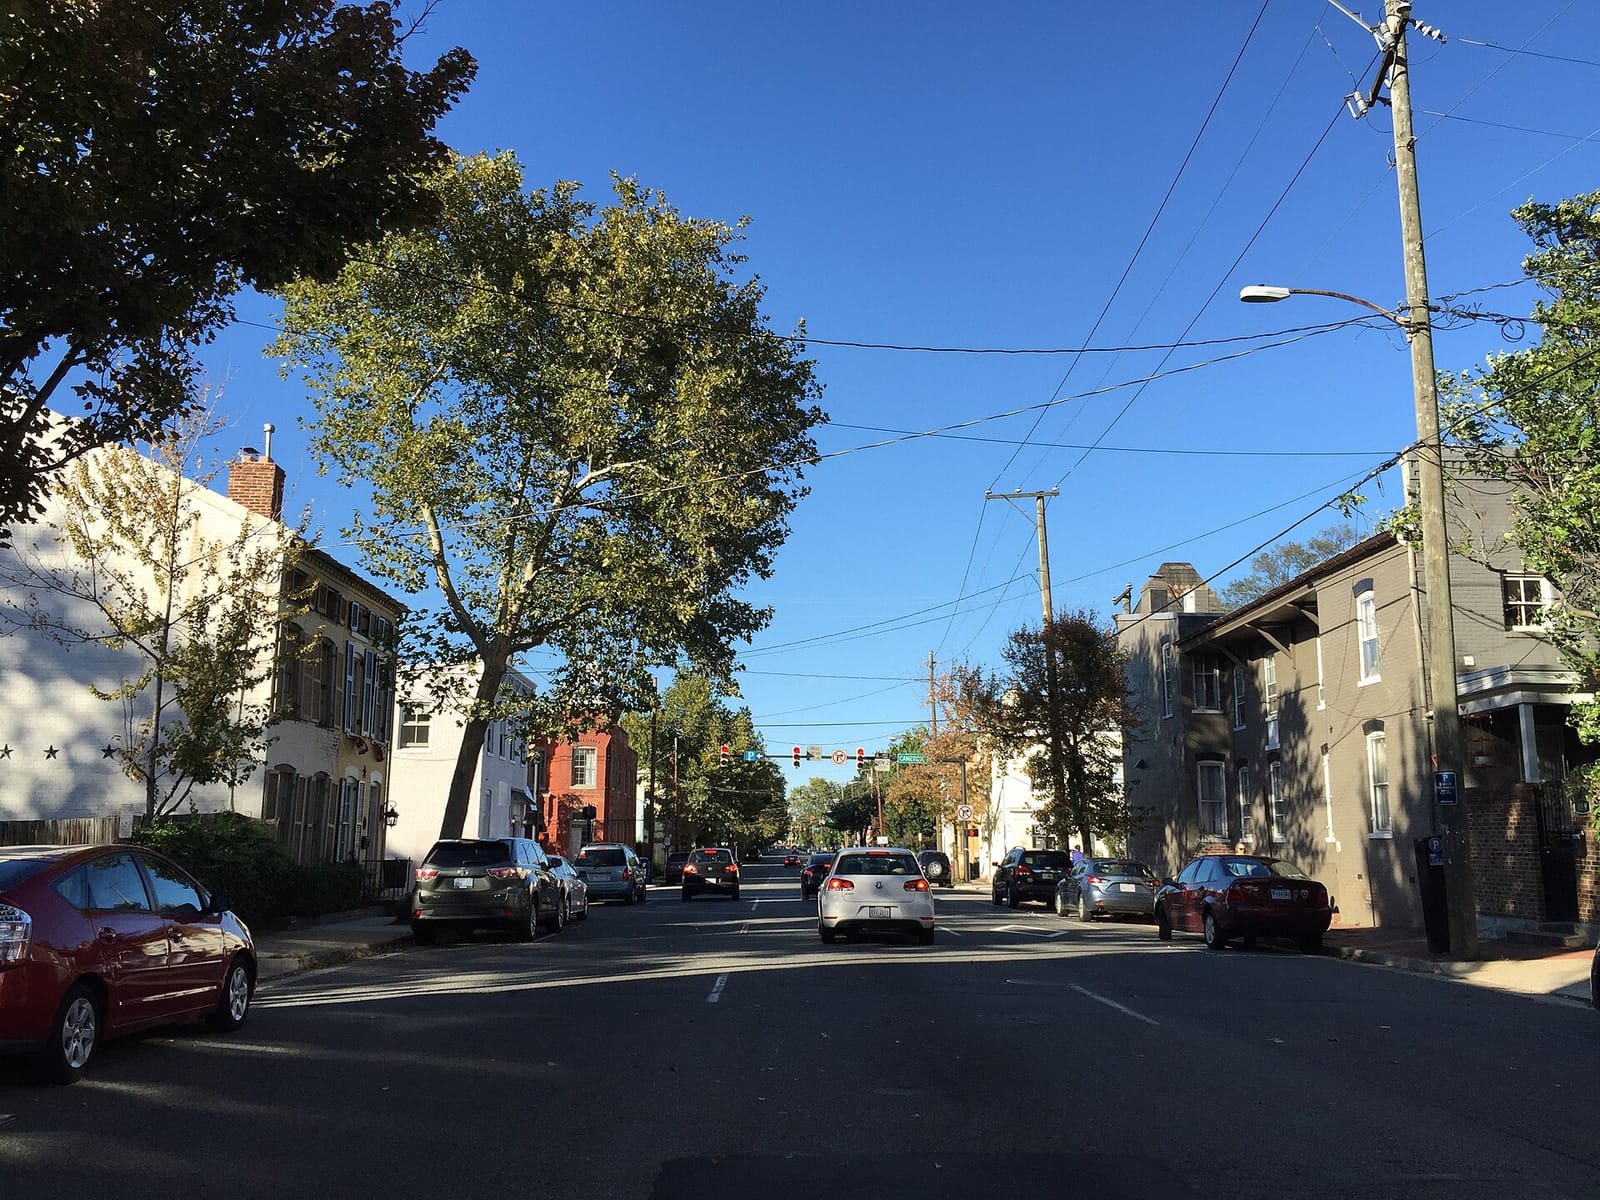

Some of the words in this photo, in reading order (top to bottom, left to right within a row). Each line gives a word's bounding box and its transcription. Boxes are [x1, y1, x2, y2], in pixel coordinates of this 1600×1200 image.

[747, 752, 754, 760] P
[1442, 774, 1448, 782] P
[1432, 840, 1439, 850] P
